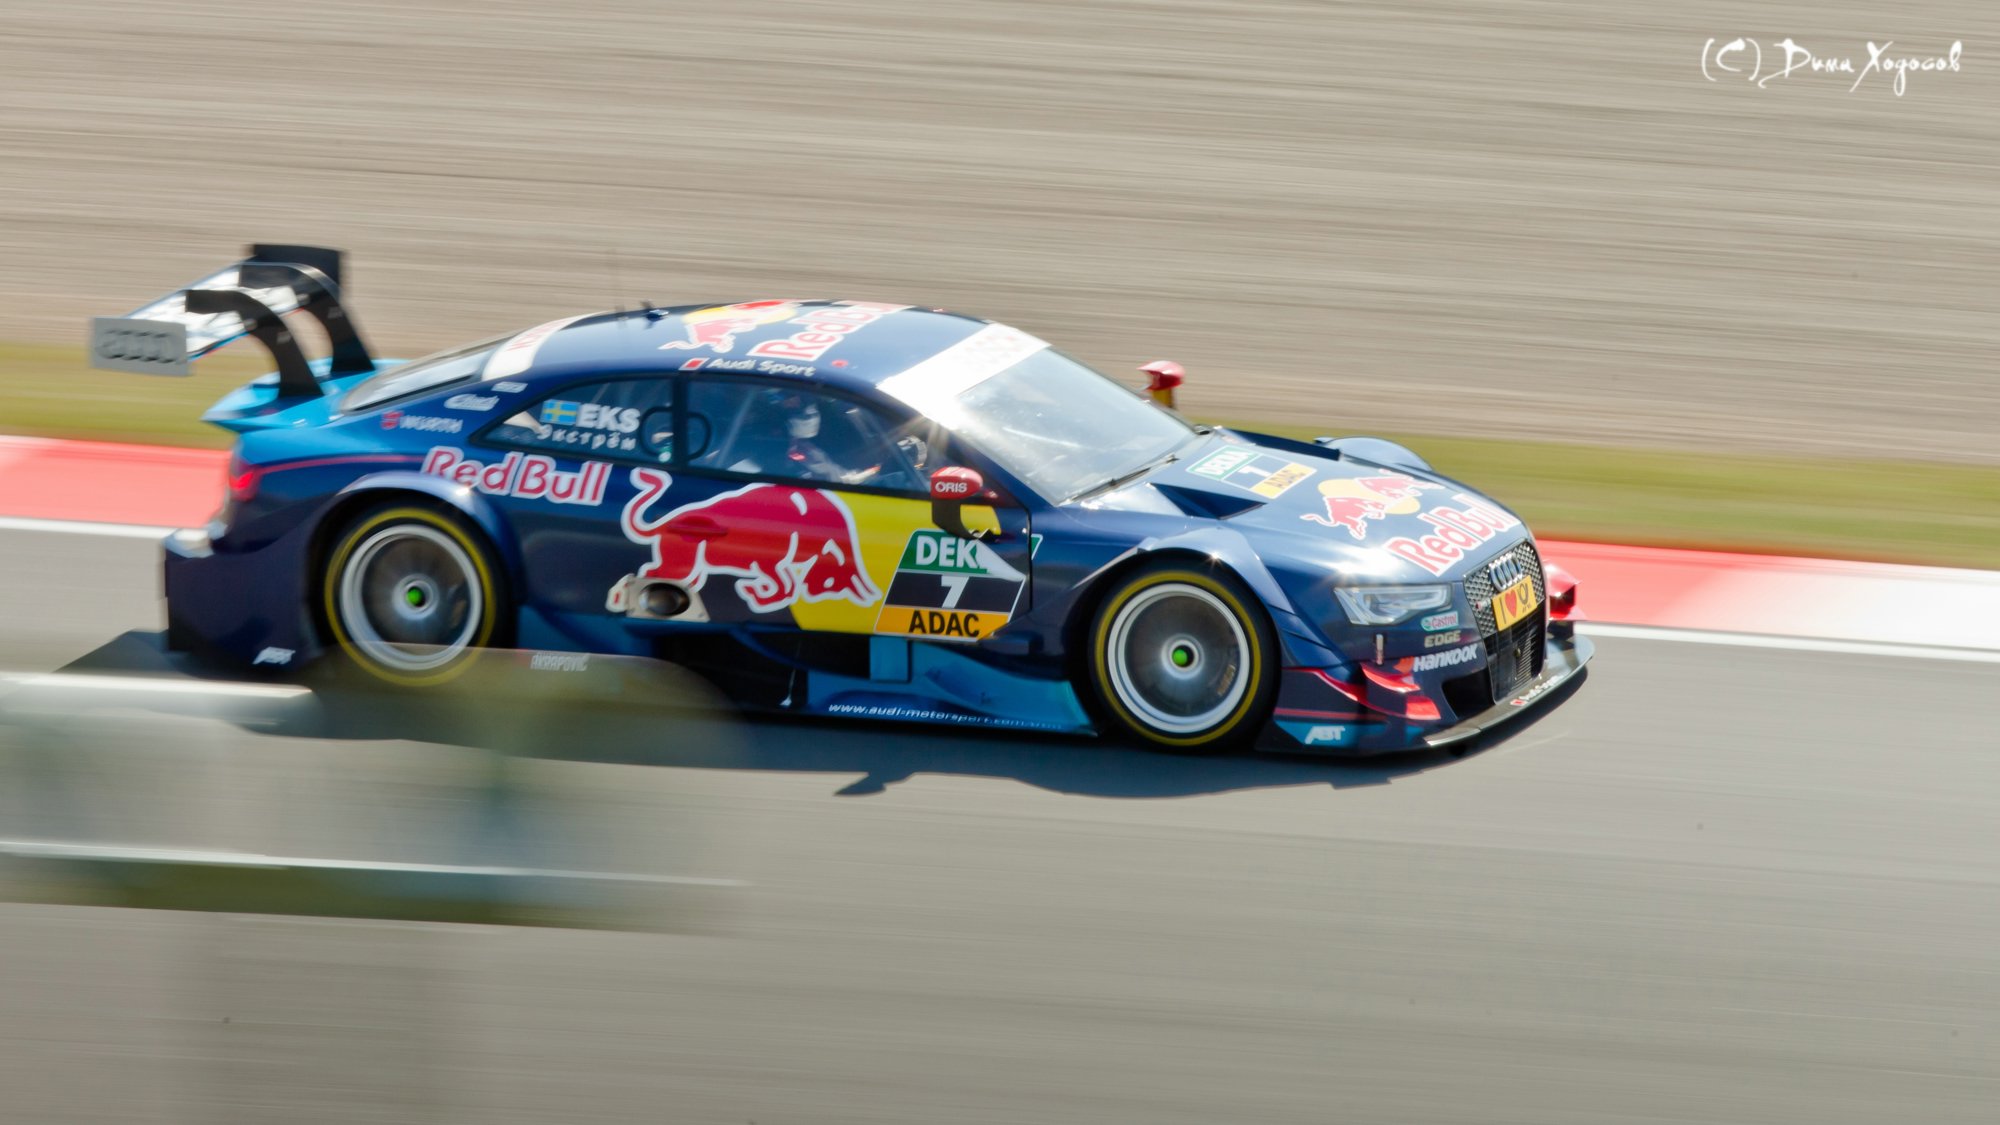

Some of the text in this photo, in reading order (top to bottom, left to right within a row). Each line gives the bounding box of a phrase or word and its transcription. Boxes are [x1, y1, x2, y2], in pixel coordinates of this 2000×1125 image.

[706, 358, 816, 377] Audi Sport
[576, 403, 641, 433] EKS
[935, 481, 968, 493] ORIS
[915, 535, 984, 569] DEK
[940, 575, 970, 609] 7
[908, 610, 980, 638] ADAC
[1424, 630, 1461, 648] EDGE
[1304, 725, 1346, 745] ABT
